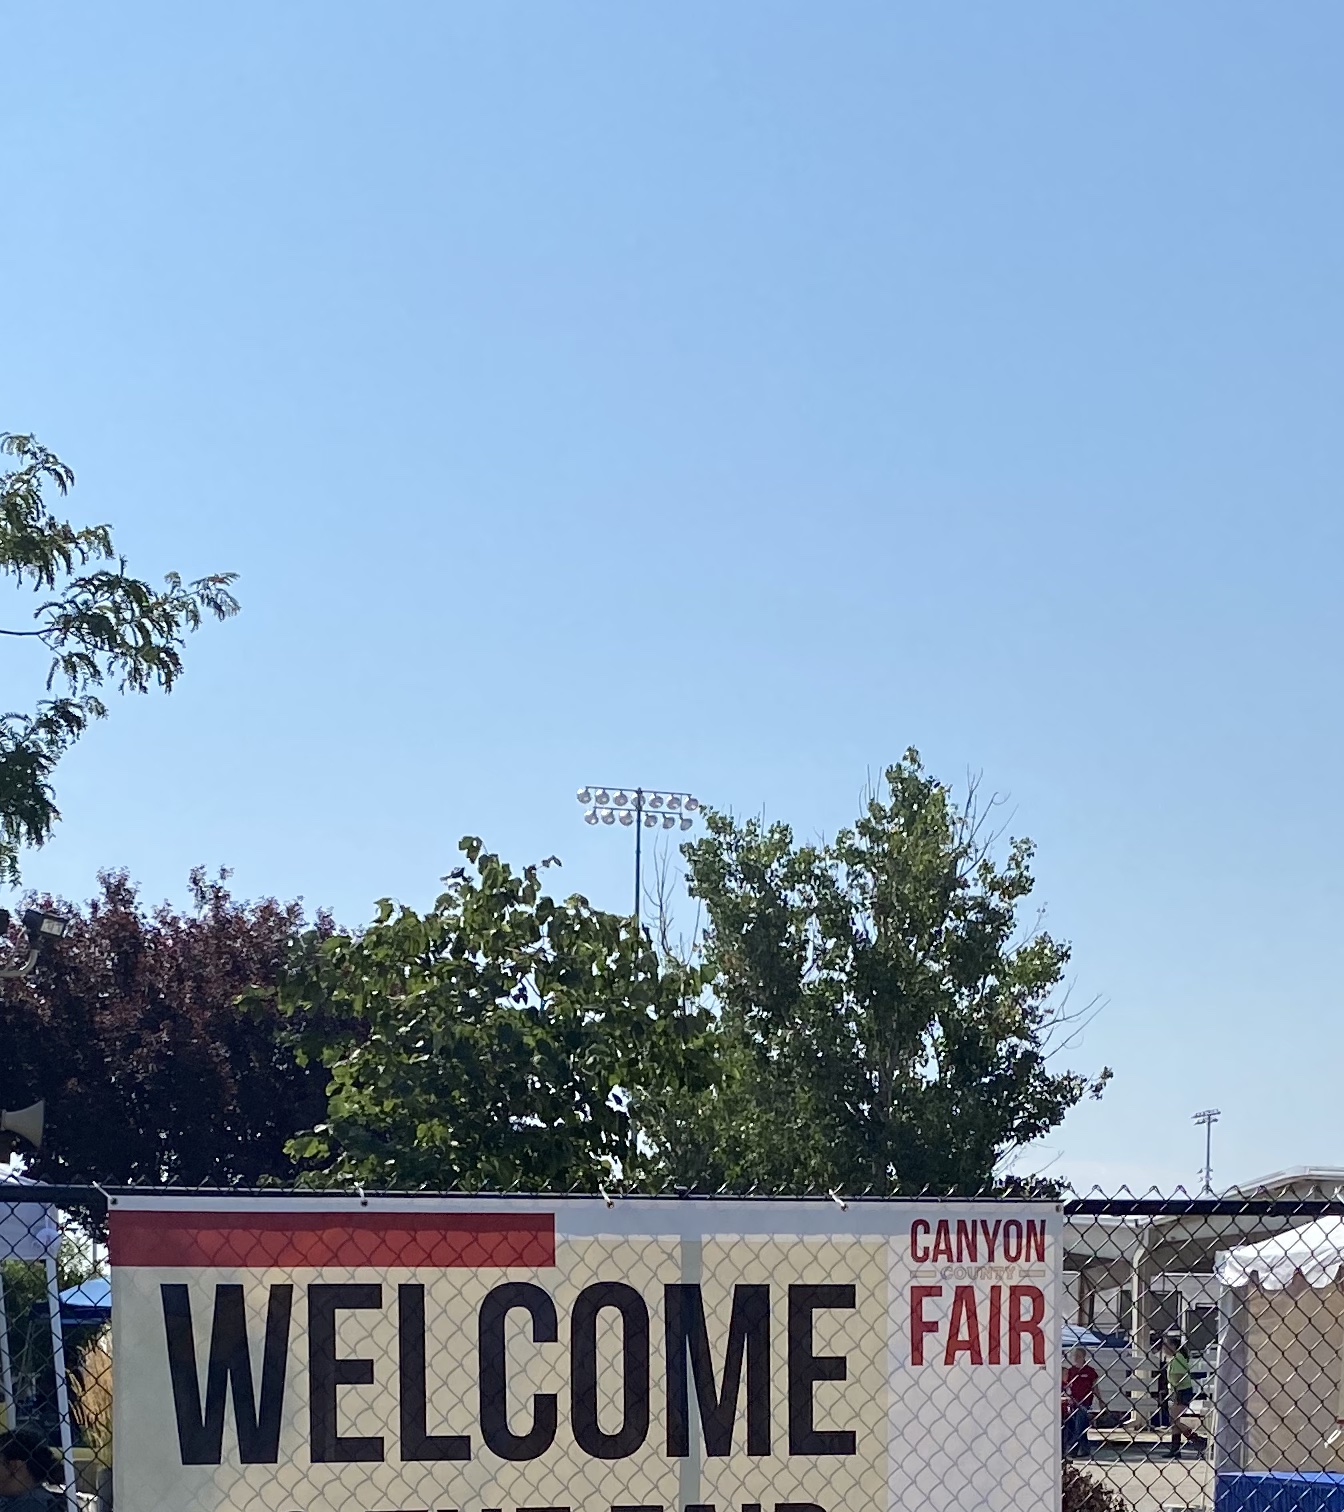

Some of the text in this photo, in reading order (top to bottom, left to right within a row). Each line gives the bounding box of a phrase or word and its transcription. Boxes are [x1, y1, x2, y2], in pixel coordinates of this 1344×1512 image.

[910, 1218, 1047, 1263] CANYON
[940, 1265, 1016, 1281] COUNTY
[910, 1284, 1046, 1366] FAIR
[159, 1280, 857, 1466] WELCOME
